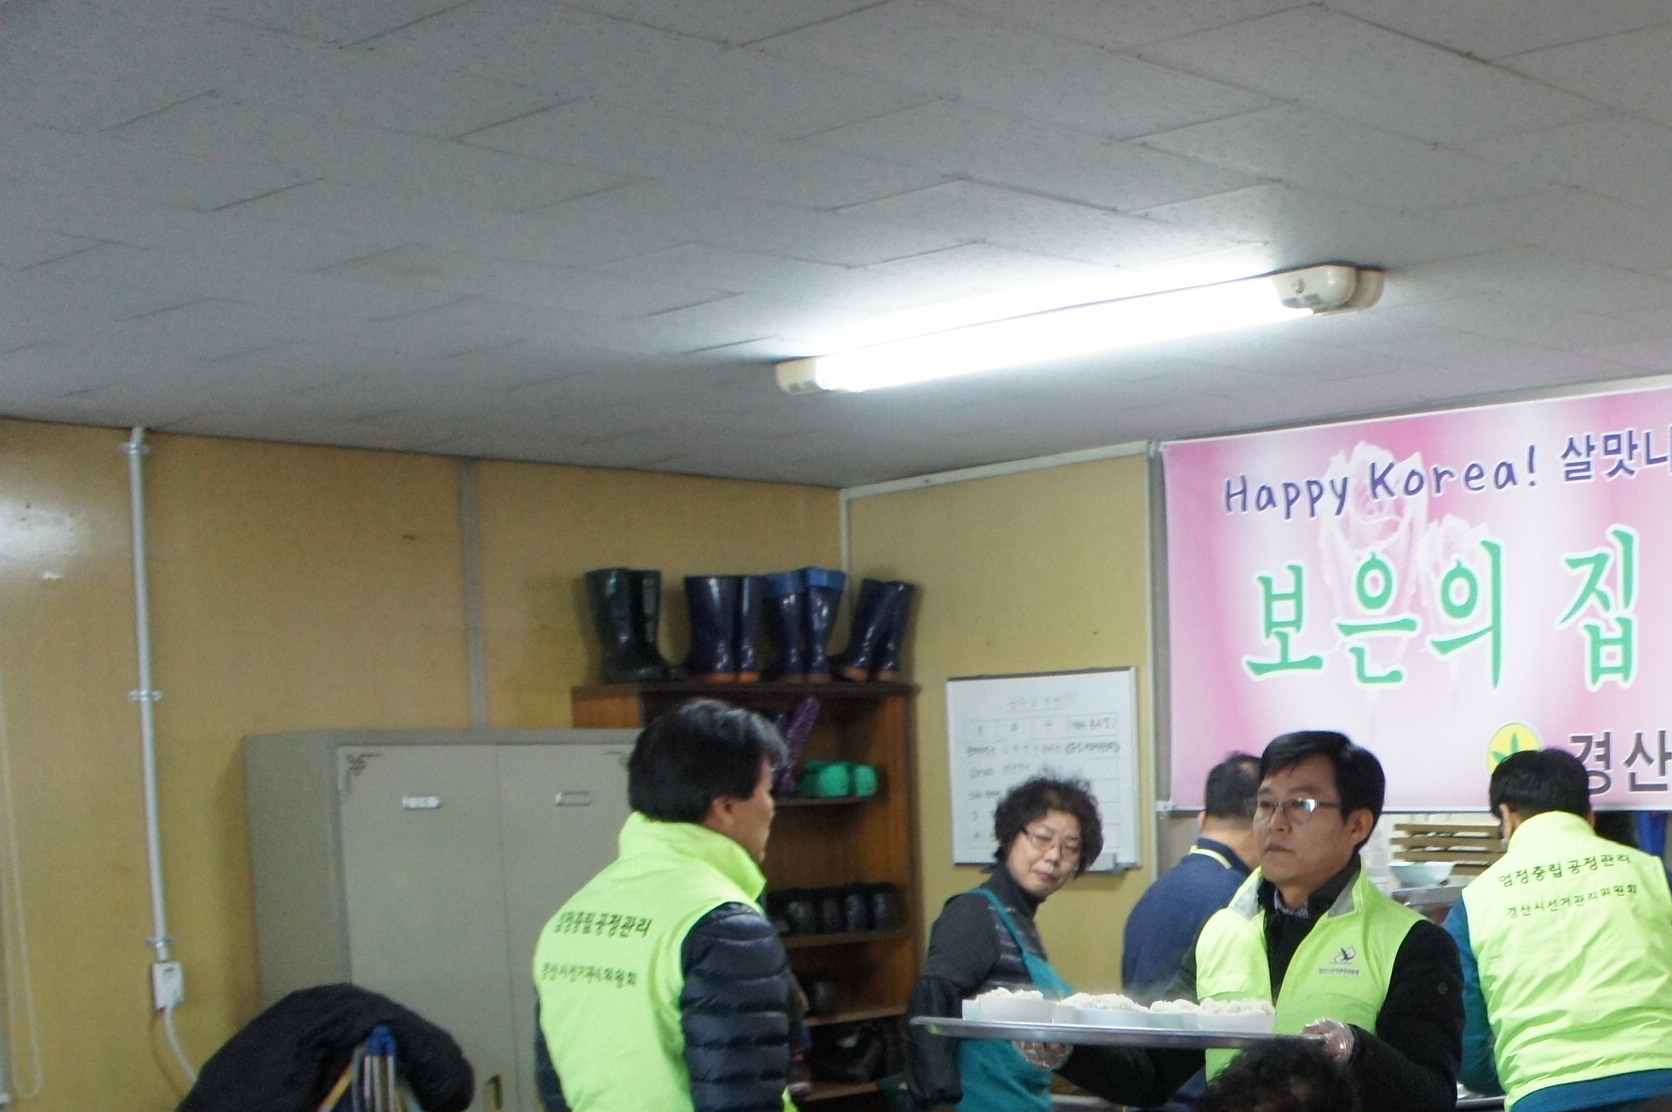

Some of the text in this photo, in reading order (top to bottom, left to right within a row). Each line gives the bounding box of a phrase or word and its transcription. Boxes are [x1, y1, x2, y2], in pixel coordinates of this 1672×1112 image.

[1224, 474, 1349, 518] Happy
[1369, 446, 1537, 501] Korea!
[1243, 540, 1503, 688] 보은의
[1557, 530, 1638, 684] 집
